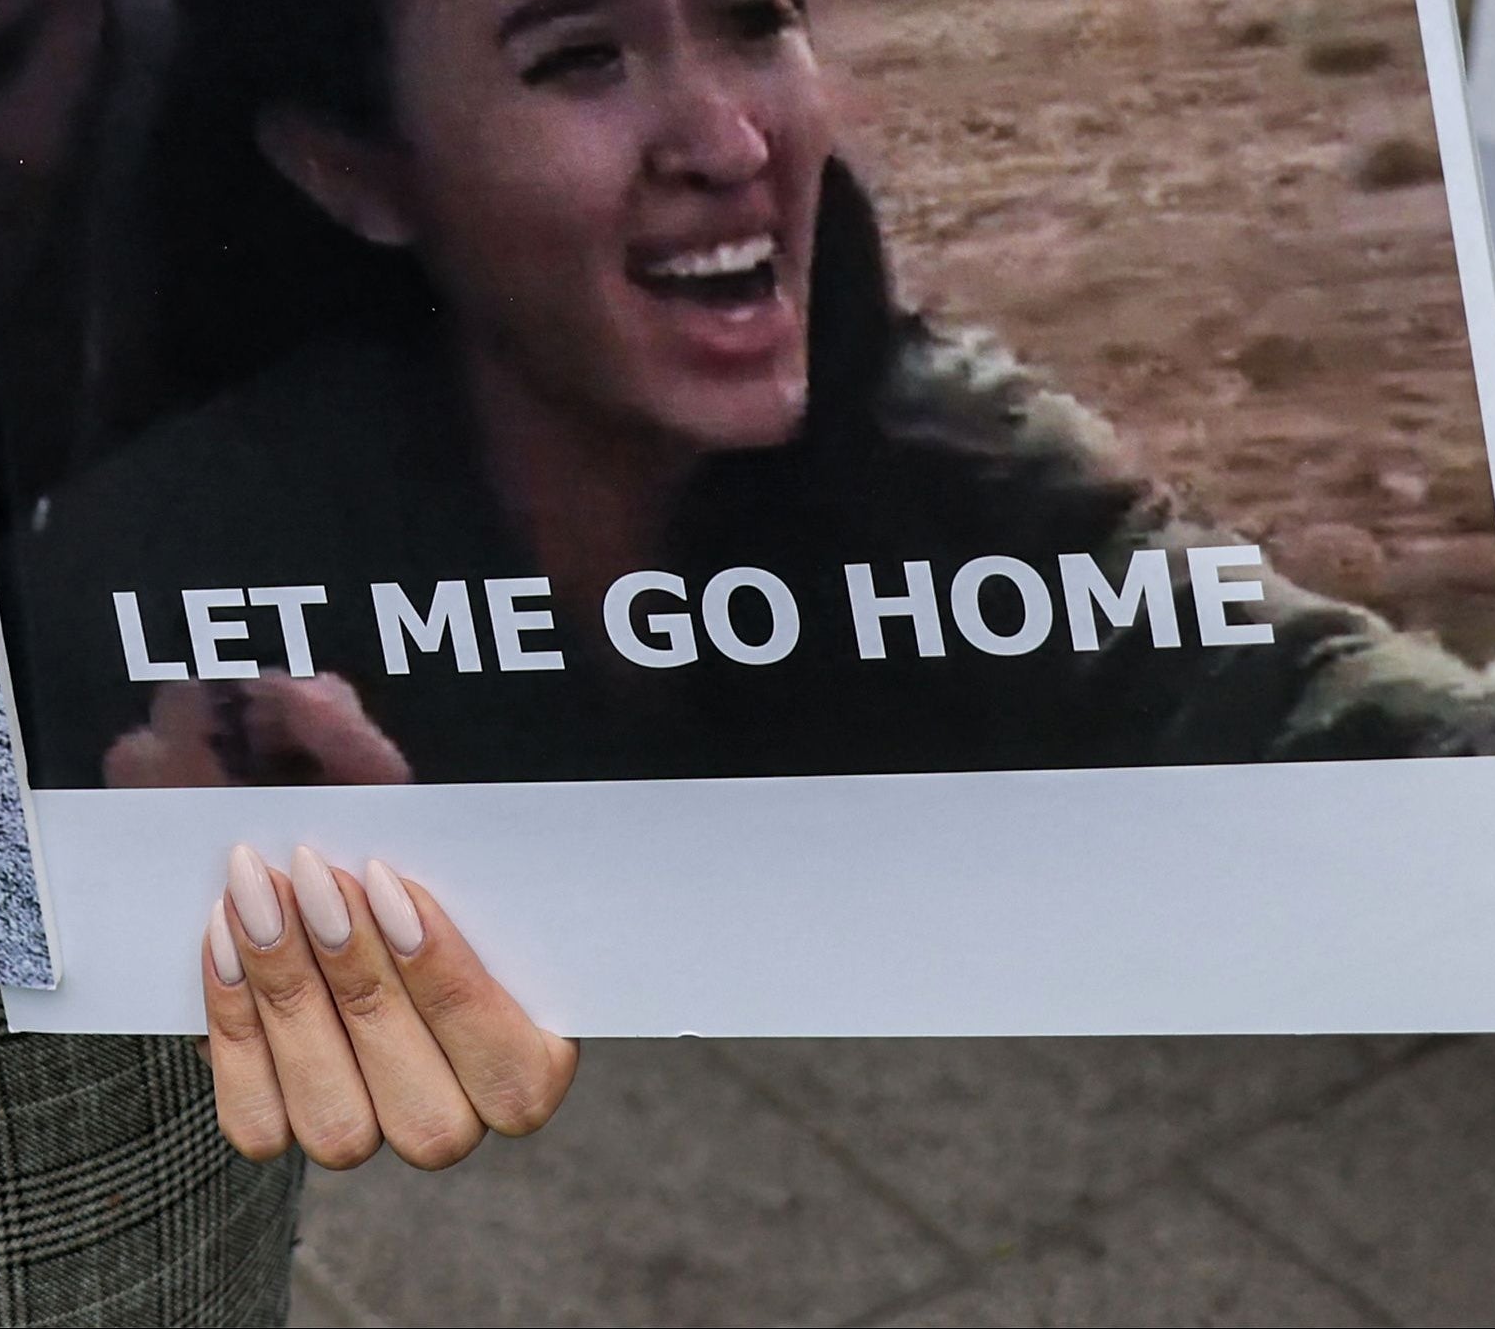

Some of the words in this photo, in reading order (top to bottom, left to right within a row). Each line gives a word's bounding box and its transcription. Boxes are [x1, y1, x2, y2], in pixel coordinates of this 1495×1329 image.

[112, 584, 328, 683] LET
[371, 577, 566, 674] ME
[603, 567, 800, 667] GO
[845, 544, 1277, 660] HOME
